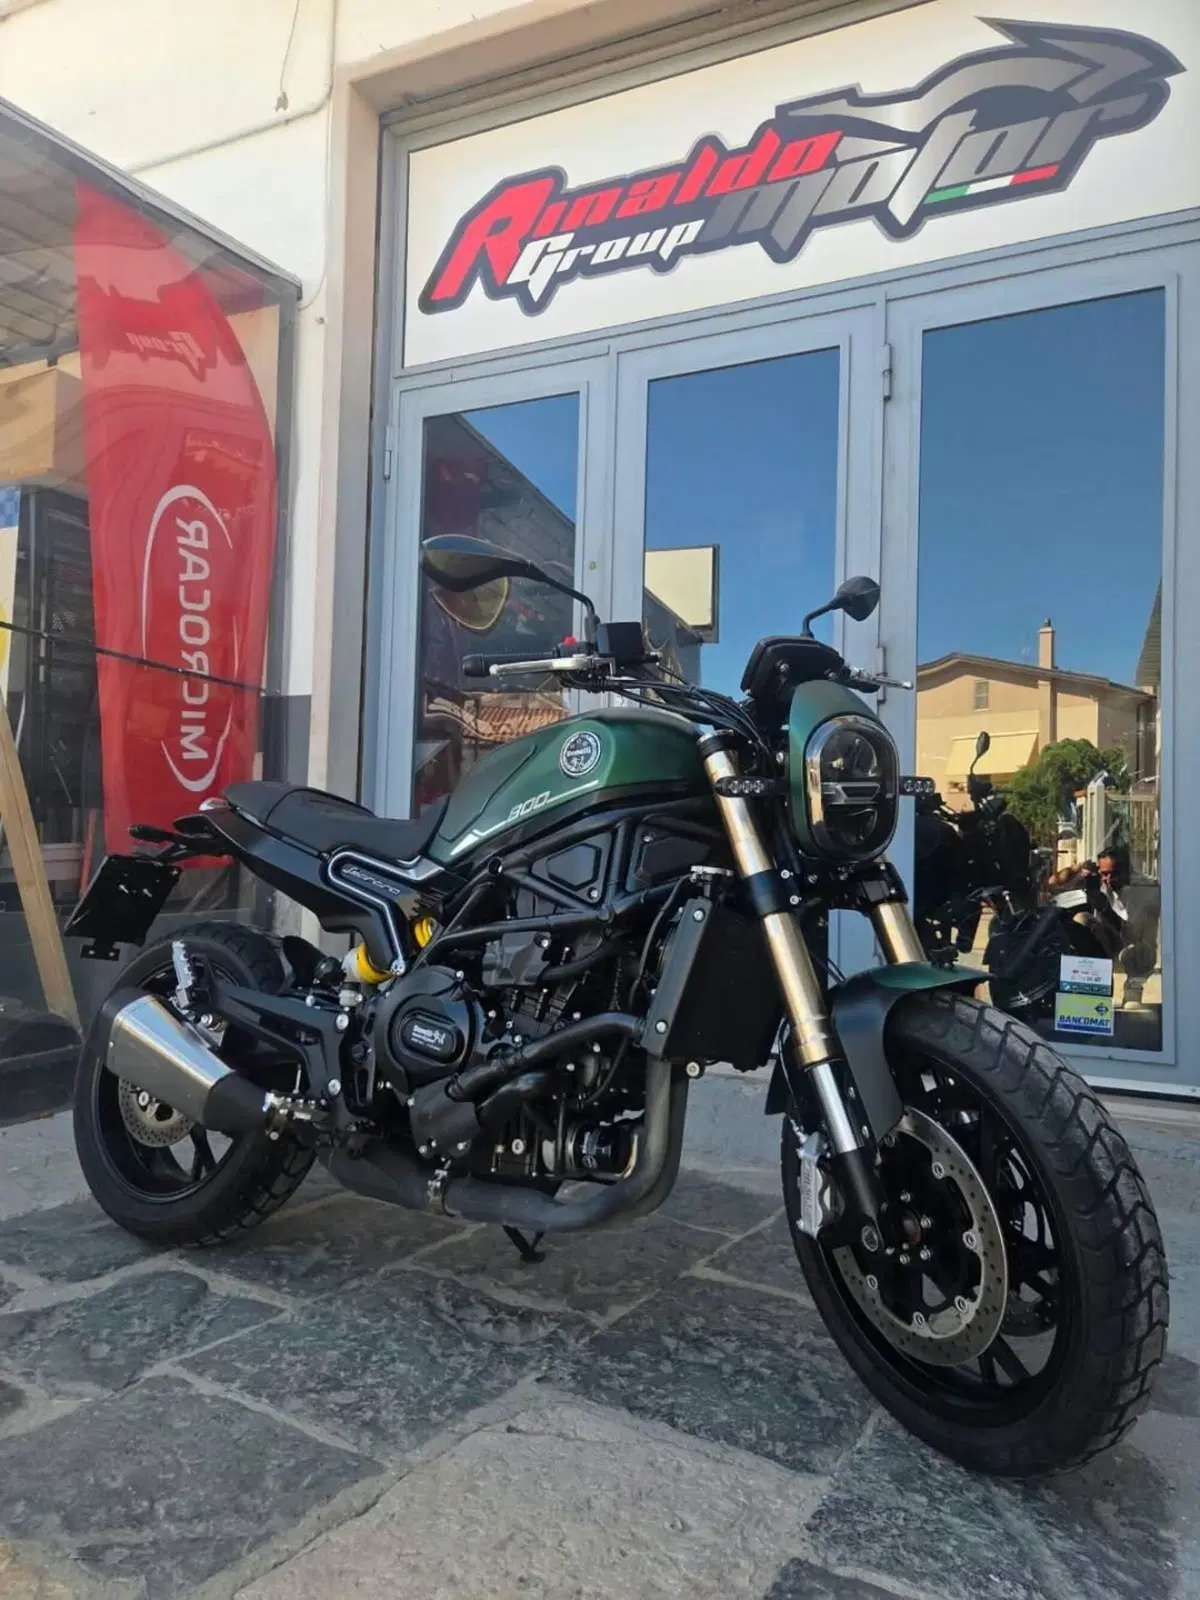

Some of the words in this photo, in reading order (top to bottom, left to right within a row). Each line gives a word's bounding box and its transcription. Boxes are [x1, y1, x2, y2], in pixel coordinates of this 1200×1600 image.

[431, 127, 843, 300] Rinaldo
[507, 219, 706, 302] Group
[1058, 1014, 1109, 1027] BANCOMAT
